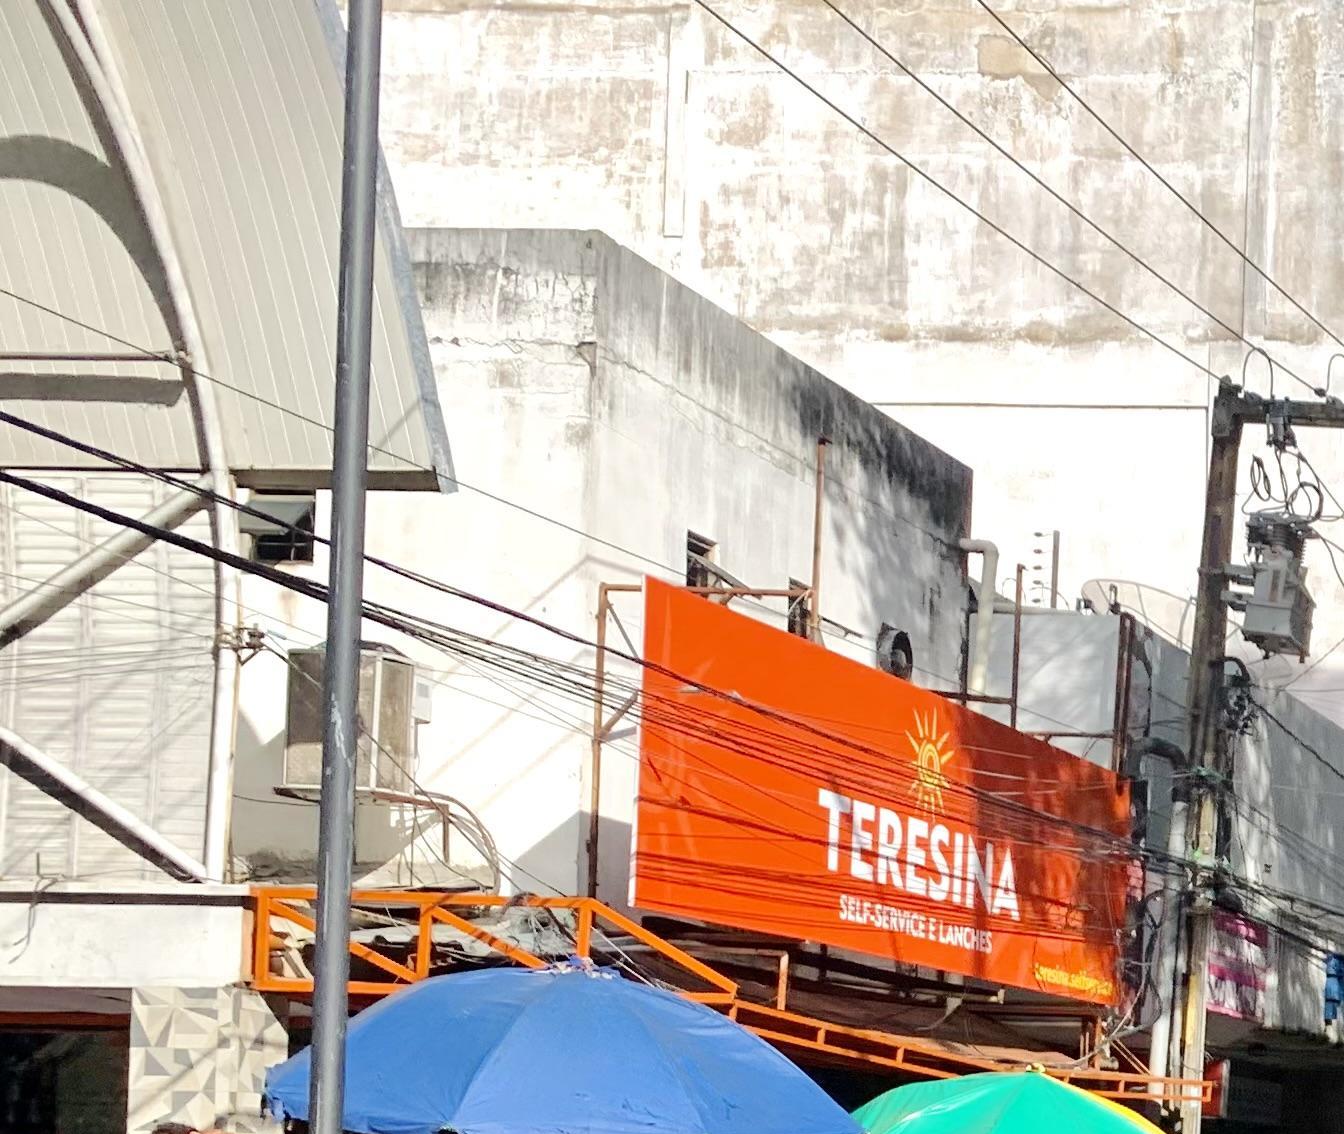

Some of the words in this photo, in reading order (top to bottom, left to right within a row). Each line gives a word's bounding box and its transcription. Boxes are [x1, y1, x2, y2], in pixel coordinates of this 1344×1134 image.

[818, 788, 1020, 922] TERESINA
[839, 894, 926, 939] SELF-SERVICE
[928, 917, 937, 935] E
[939, 921, 992, 954] LANCHES
